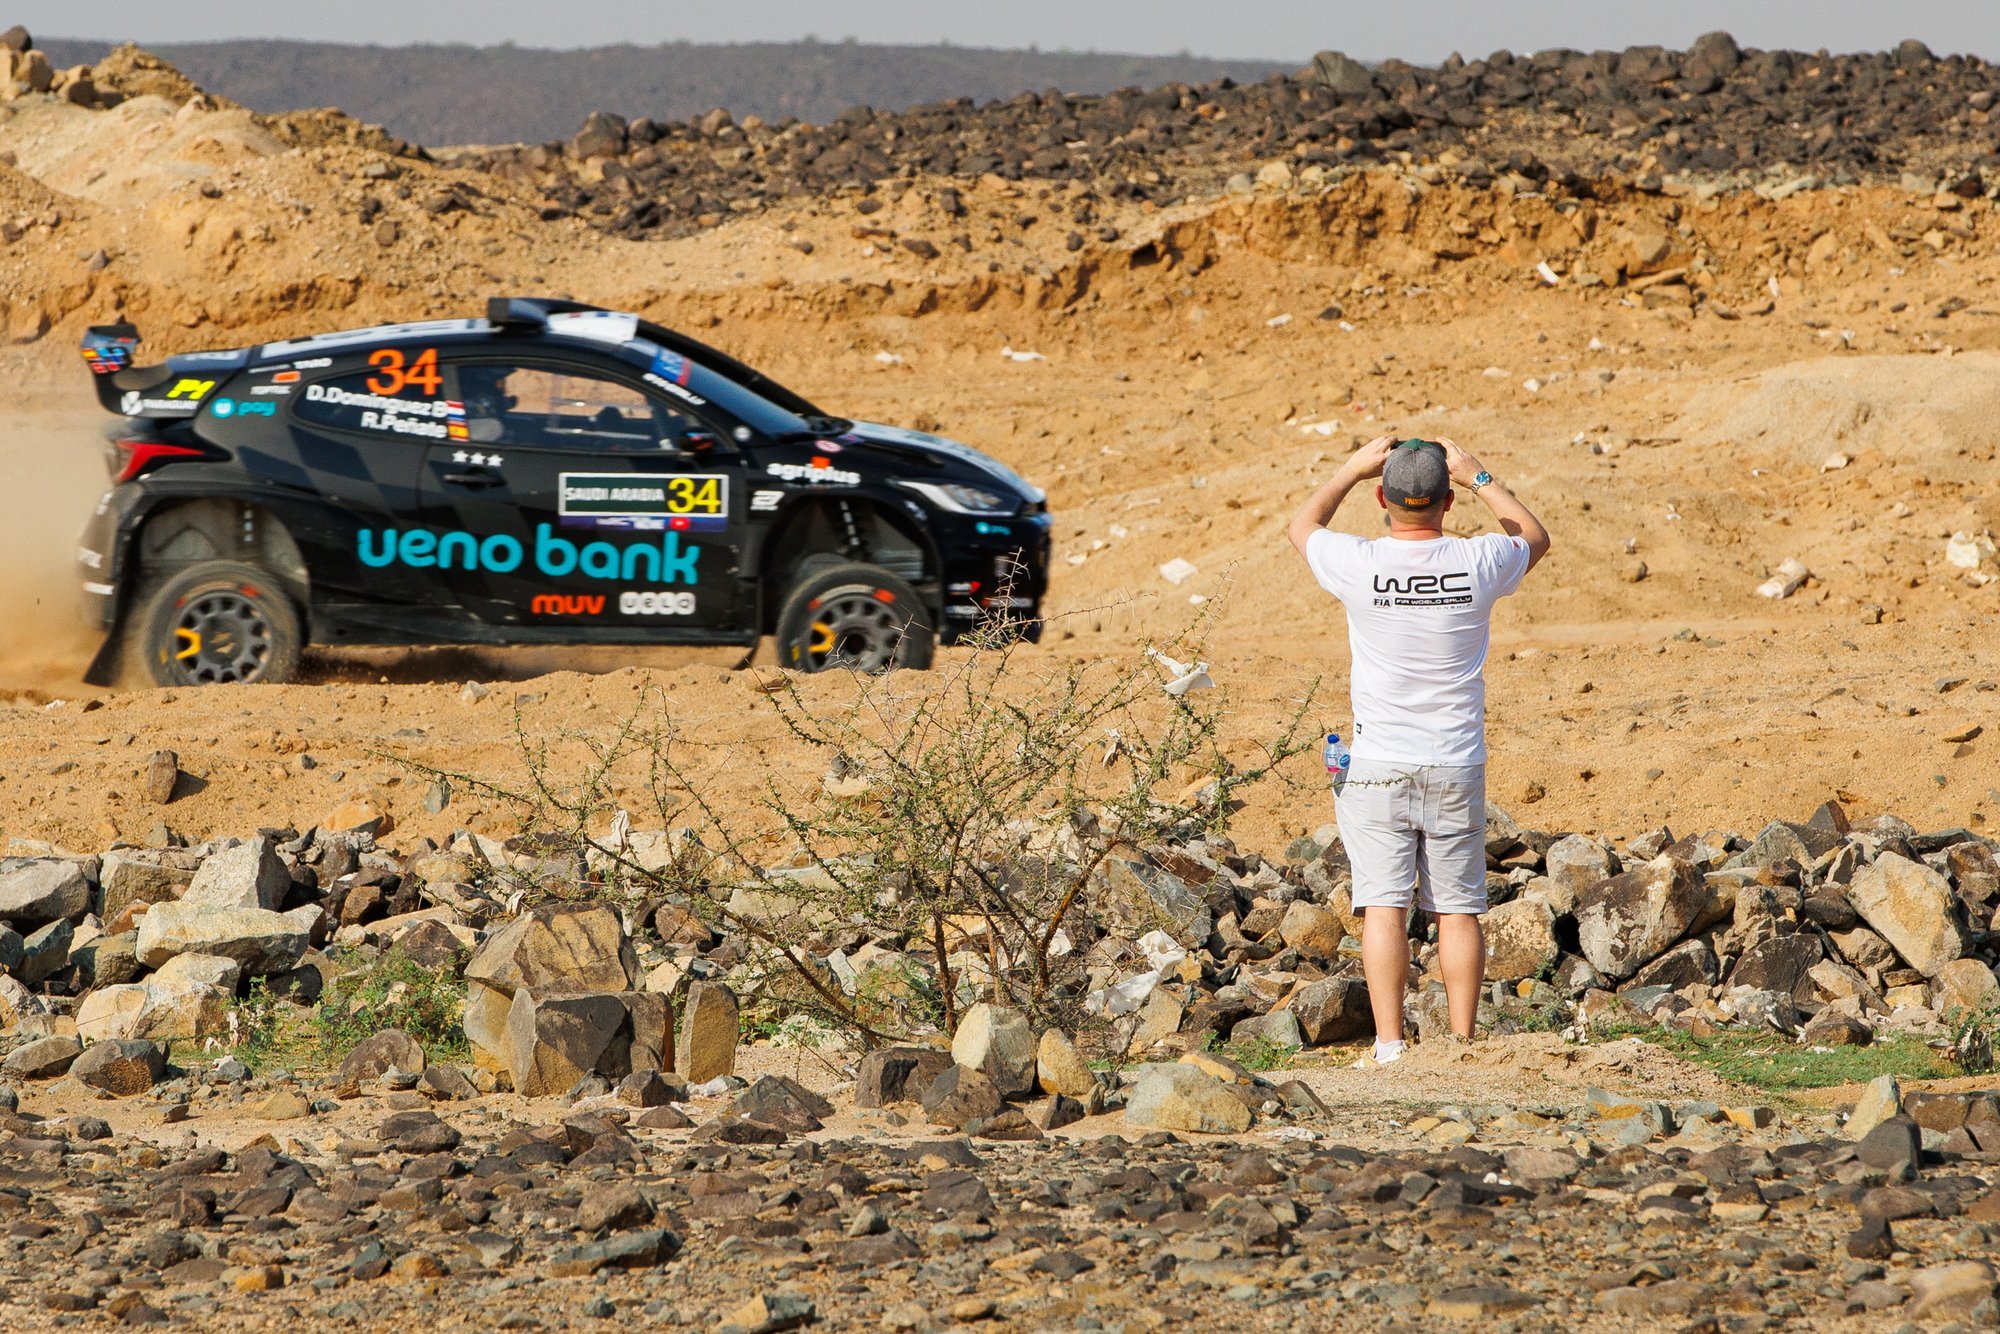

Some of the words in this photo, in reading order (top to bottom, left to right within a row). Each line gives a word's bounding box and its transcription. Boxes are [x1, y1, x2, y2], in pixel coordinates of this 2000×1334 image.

[366, 348, 443, 396] 34
[237, 401, 276, 417] pay
[766, 462, 861, 485] agriplus
[565, 487, 609, 501] SAUDI
[609, 487, 665, 501] ARABIA
[667, 477, 721, 513] 34
[357, 529, 523, 573] ueno
[535, 522, 700, 585] bank
[1373, 572, 1471, 594] WRC
[531, 594, 605, 615] muv
